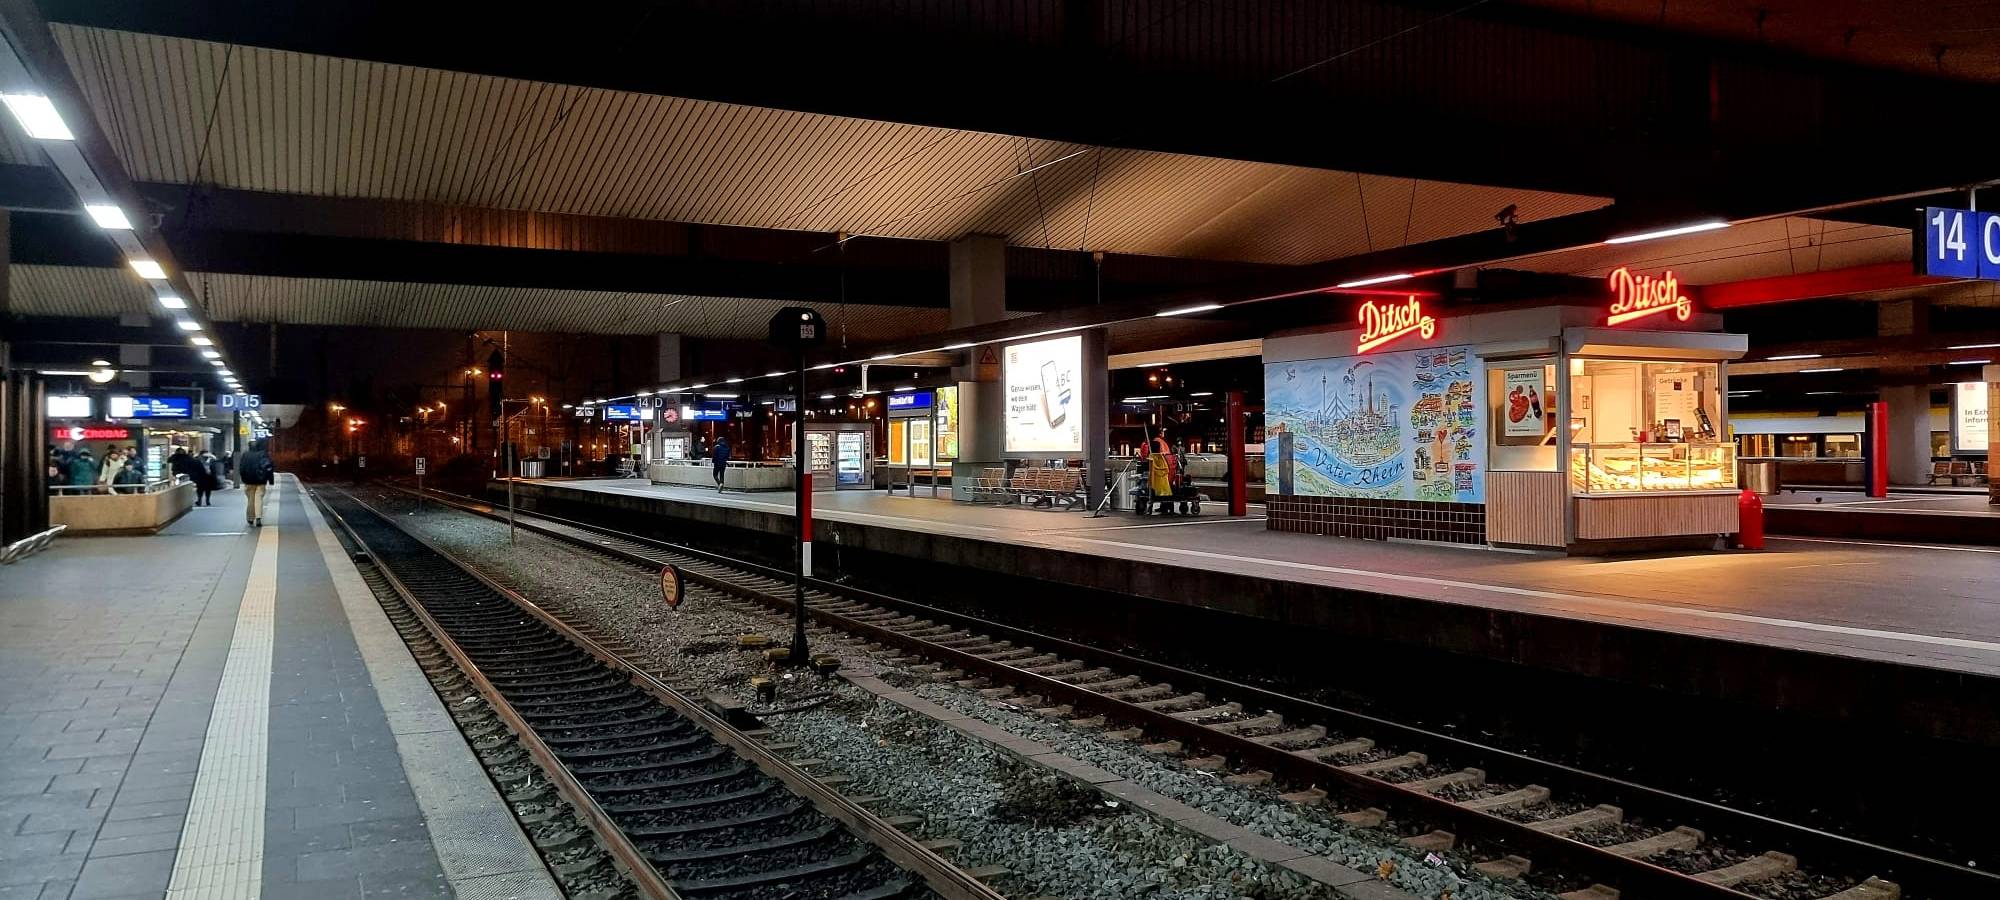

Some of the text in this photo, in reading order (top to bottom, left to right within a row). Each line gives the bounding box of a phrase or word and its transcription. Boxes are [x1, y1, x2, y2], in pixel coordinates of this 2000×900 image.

[1932, 211, 1966, 261] 14
[1609, 267, 1678, 315] Ditsch
[1358, 295, 1421, 345] Ditsch
[1507, 371, 1538, 381] Sparmenü
[223, 394, 260, 408] D 15
[637, 396, 663, 408] 14 D
[778, 398, 786, 409] D
[1734, 437, 1740, 446] 2
[417, 458, 424, 468] H
[1313, 447, 1405, 486] Vater Rhein
